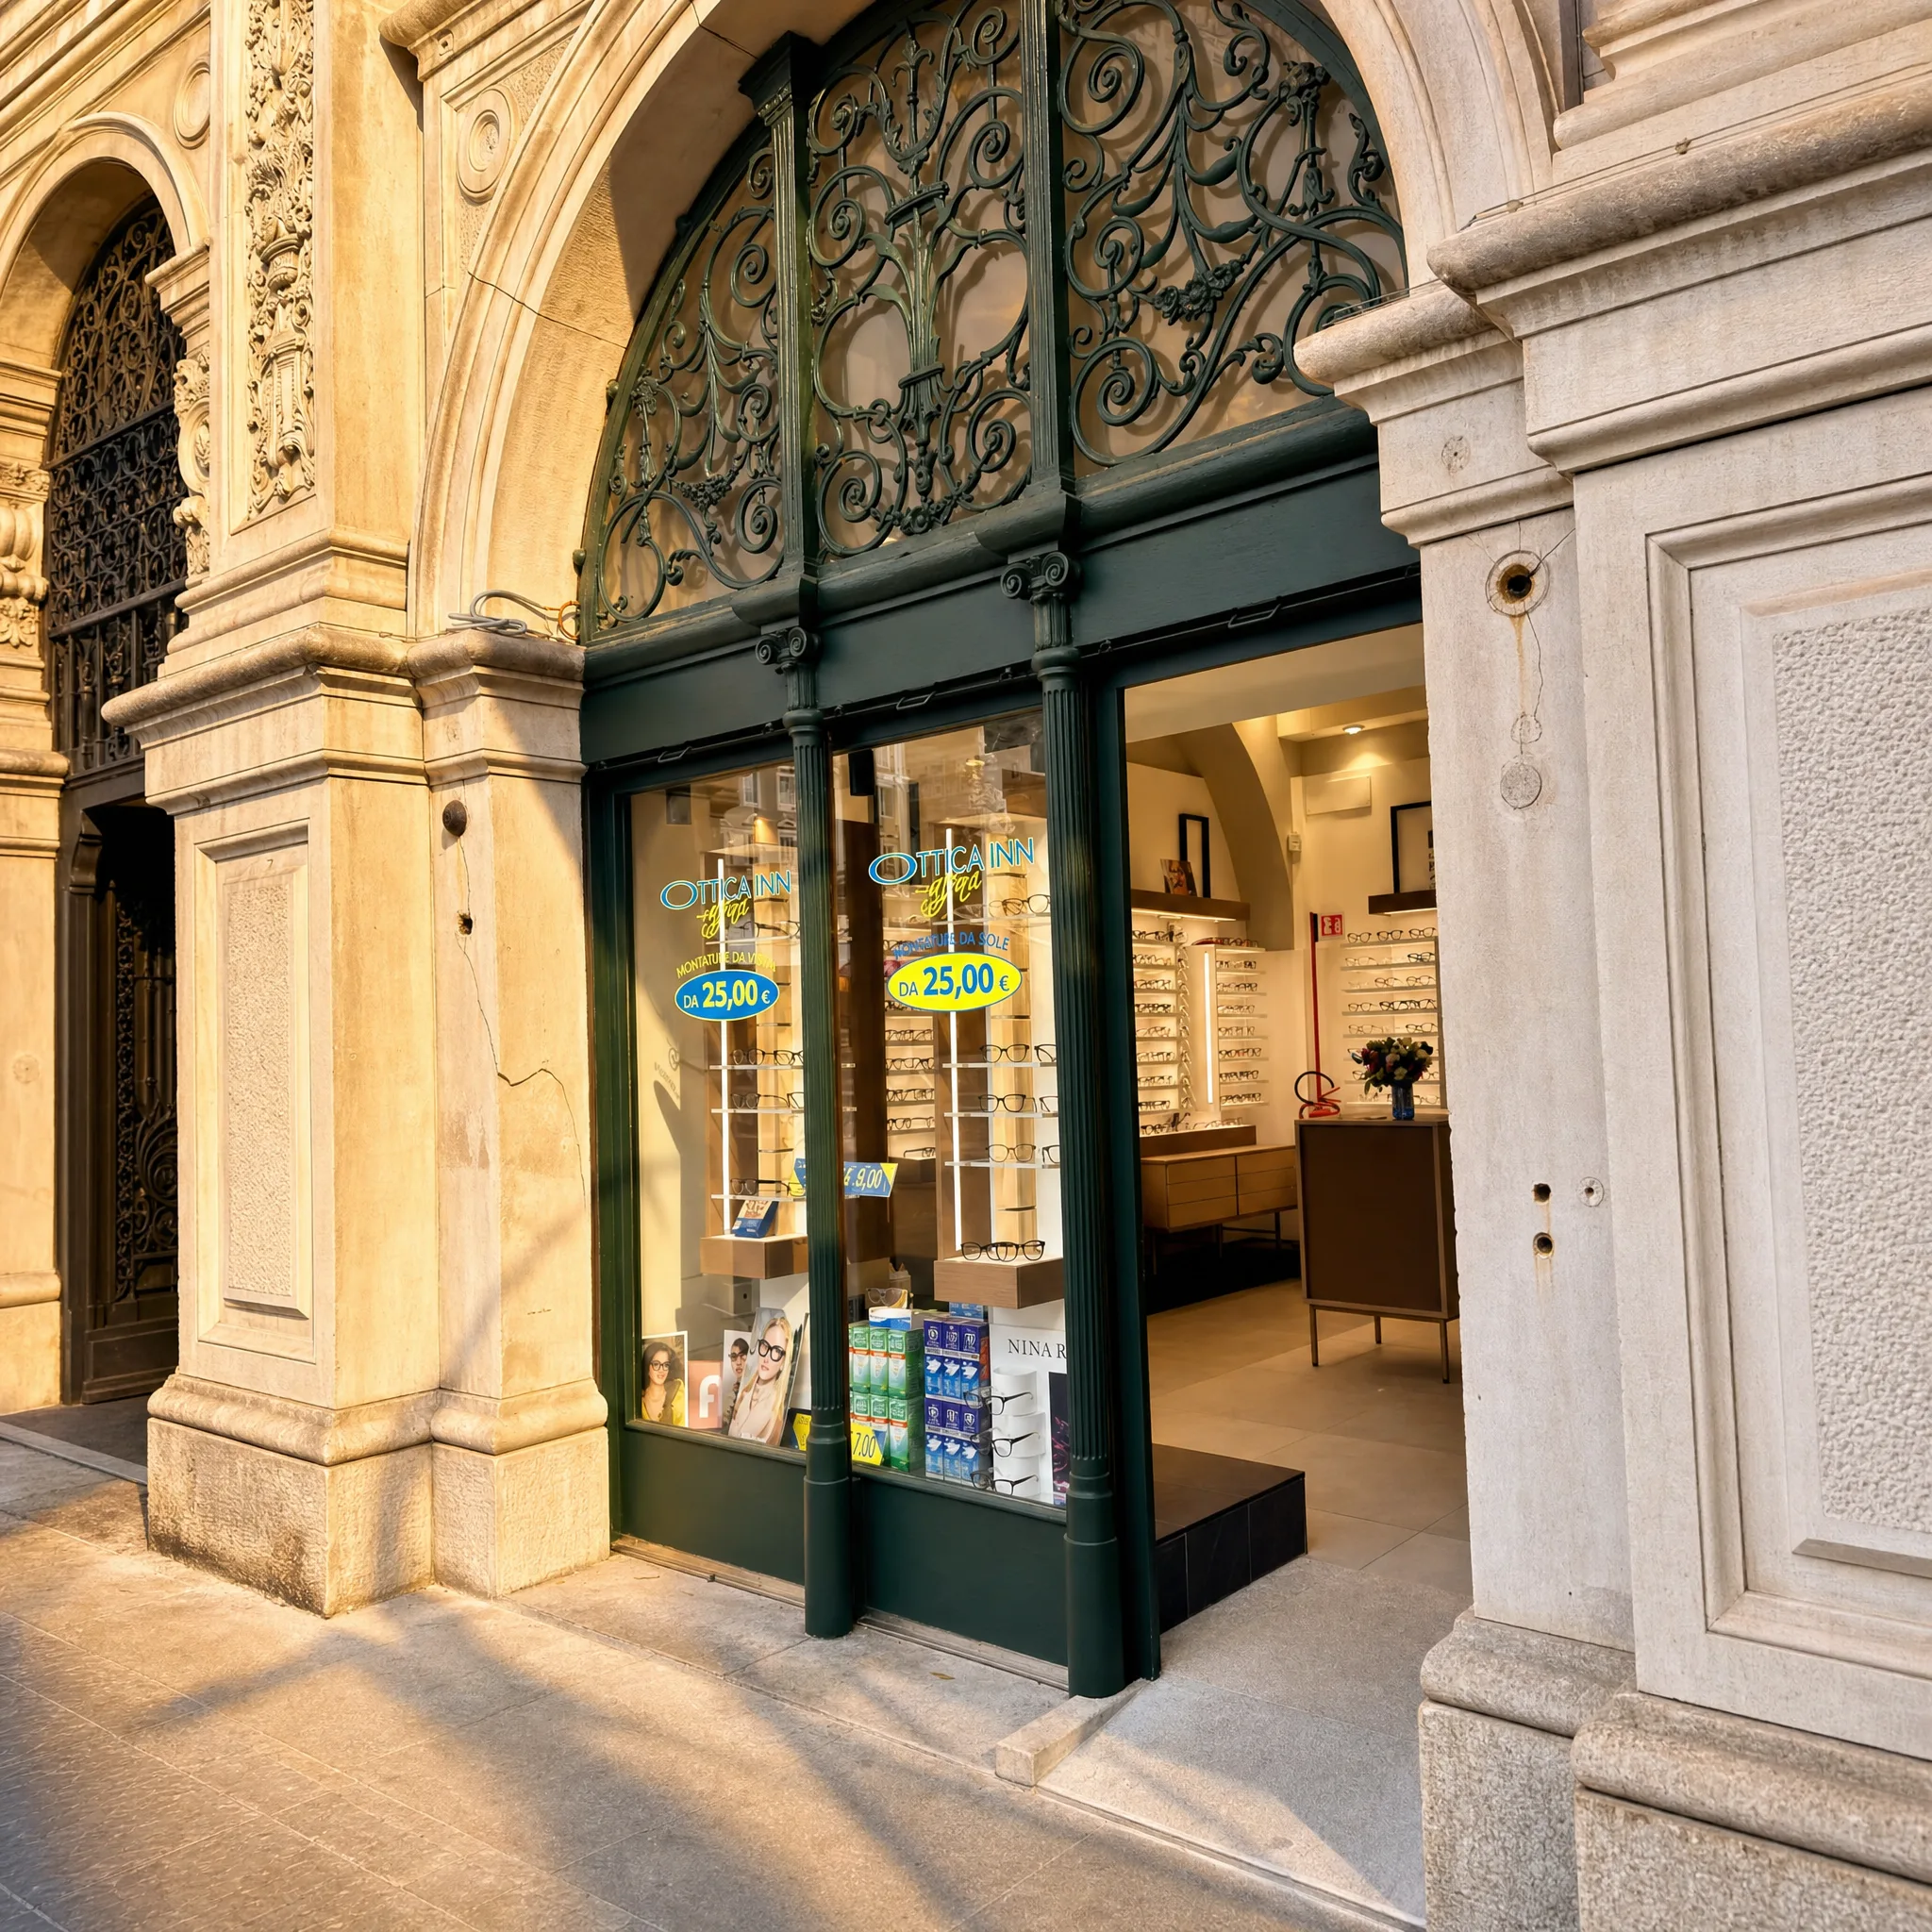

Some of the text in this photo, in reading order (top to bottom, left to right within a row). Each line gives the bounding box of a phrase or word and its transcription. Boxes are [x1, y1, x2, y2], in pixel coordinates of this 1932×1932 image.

[868, 837, 1035, 886] OTTICA INN
[660, 870, 791, 910] OTTICA INN
[732, 951, 745, 963] DA
[959, 931, 975, 946] DA
[978, 933, 1009, 951] SOLE
[683, 978, 771, 1011] DA 25,00 €
[899, 962, 1010, 1000] DA 25,00 €
[1007, 1339, 1053, 1357] NINA
